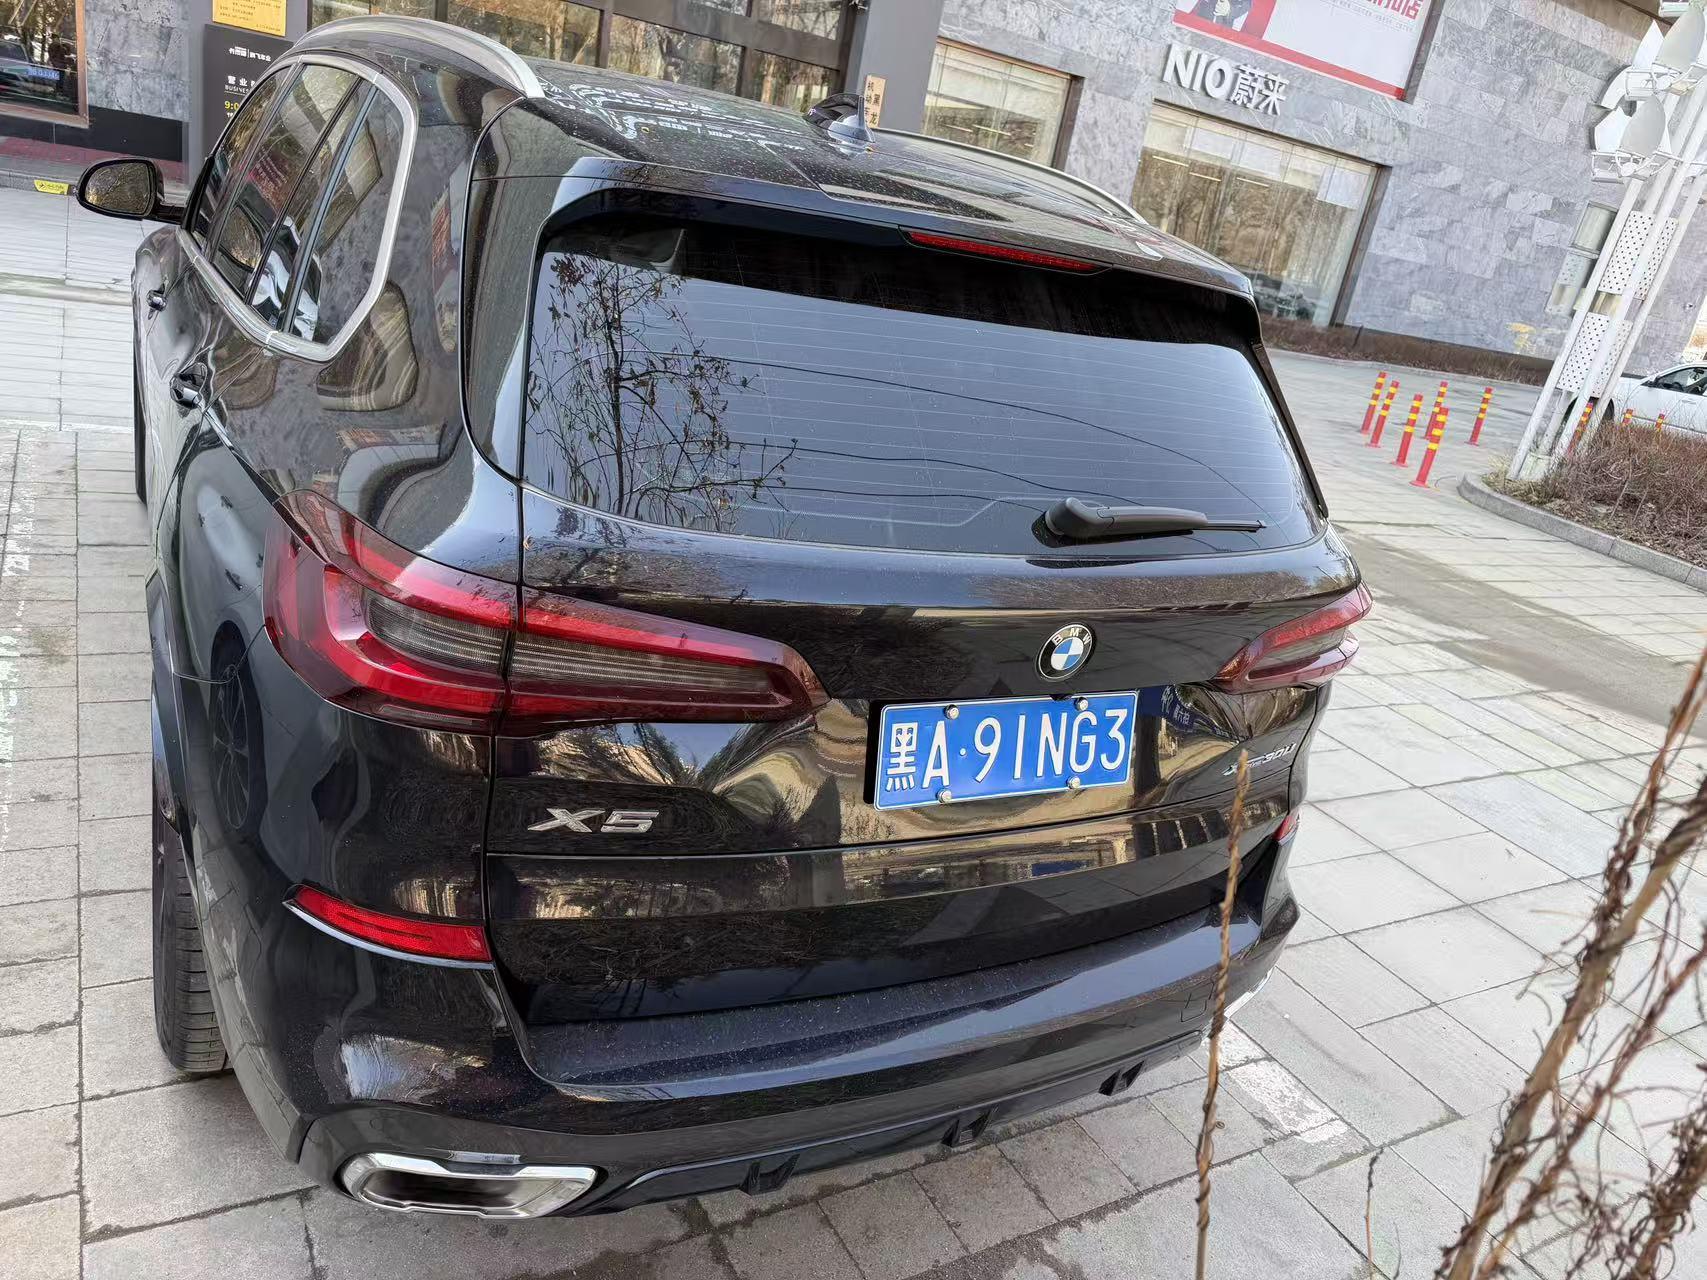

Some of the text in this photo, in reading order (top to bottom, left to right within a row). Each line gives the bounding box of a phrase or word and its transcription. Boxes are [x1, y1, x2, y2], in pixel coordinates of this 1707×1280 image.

[1162, 41, 1290, 116] NIO 蔚来
[1051, 627, 1091, 646] BMW
[528, 808, 660, 833] X5
